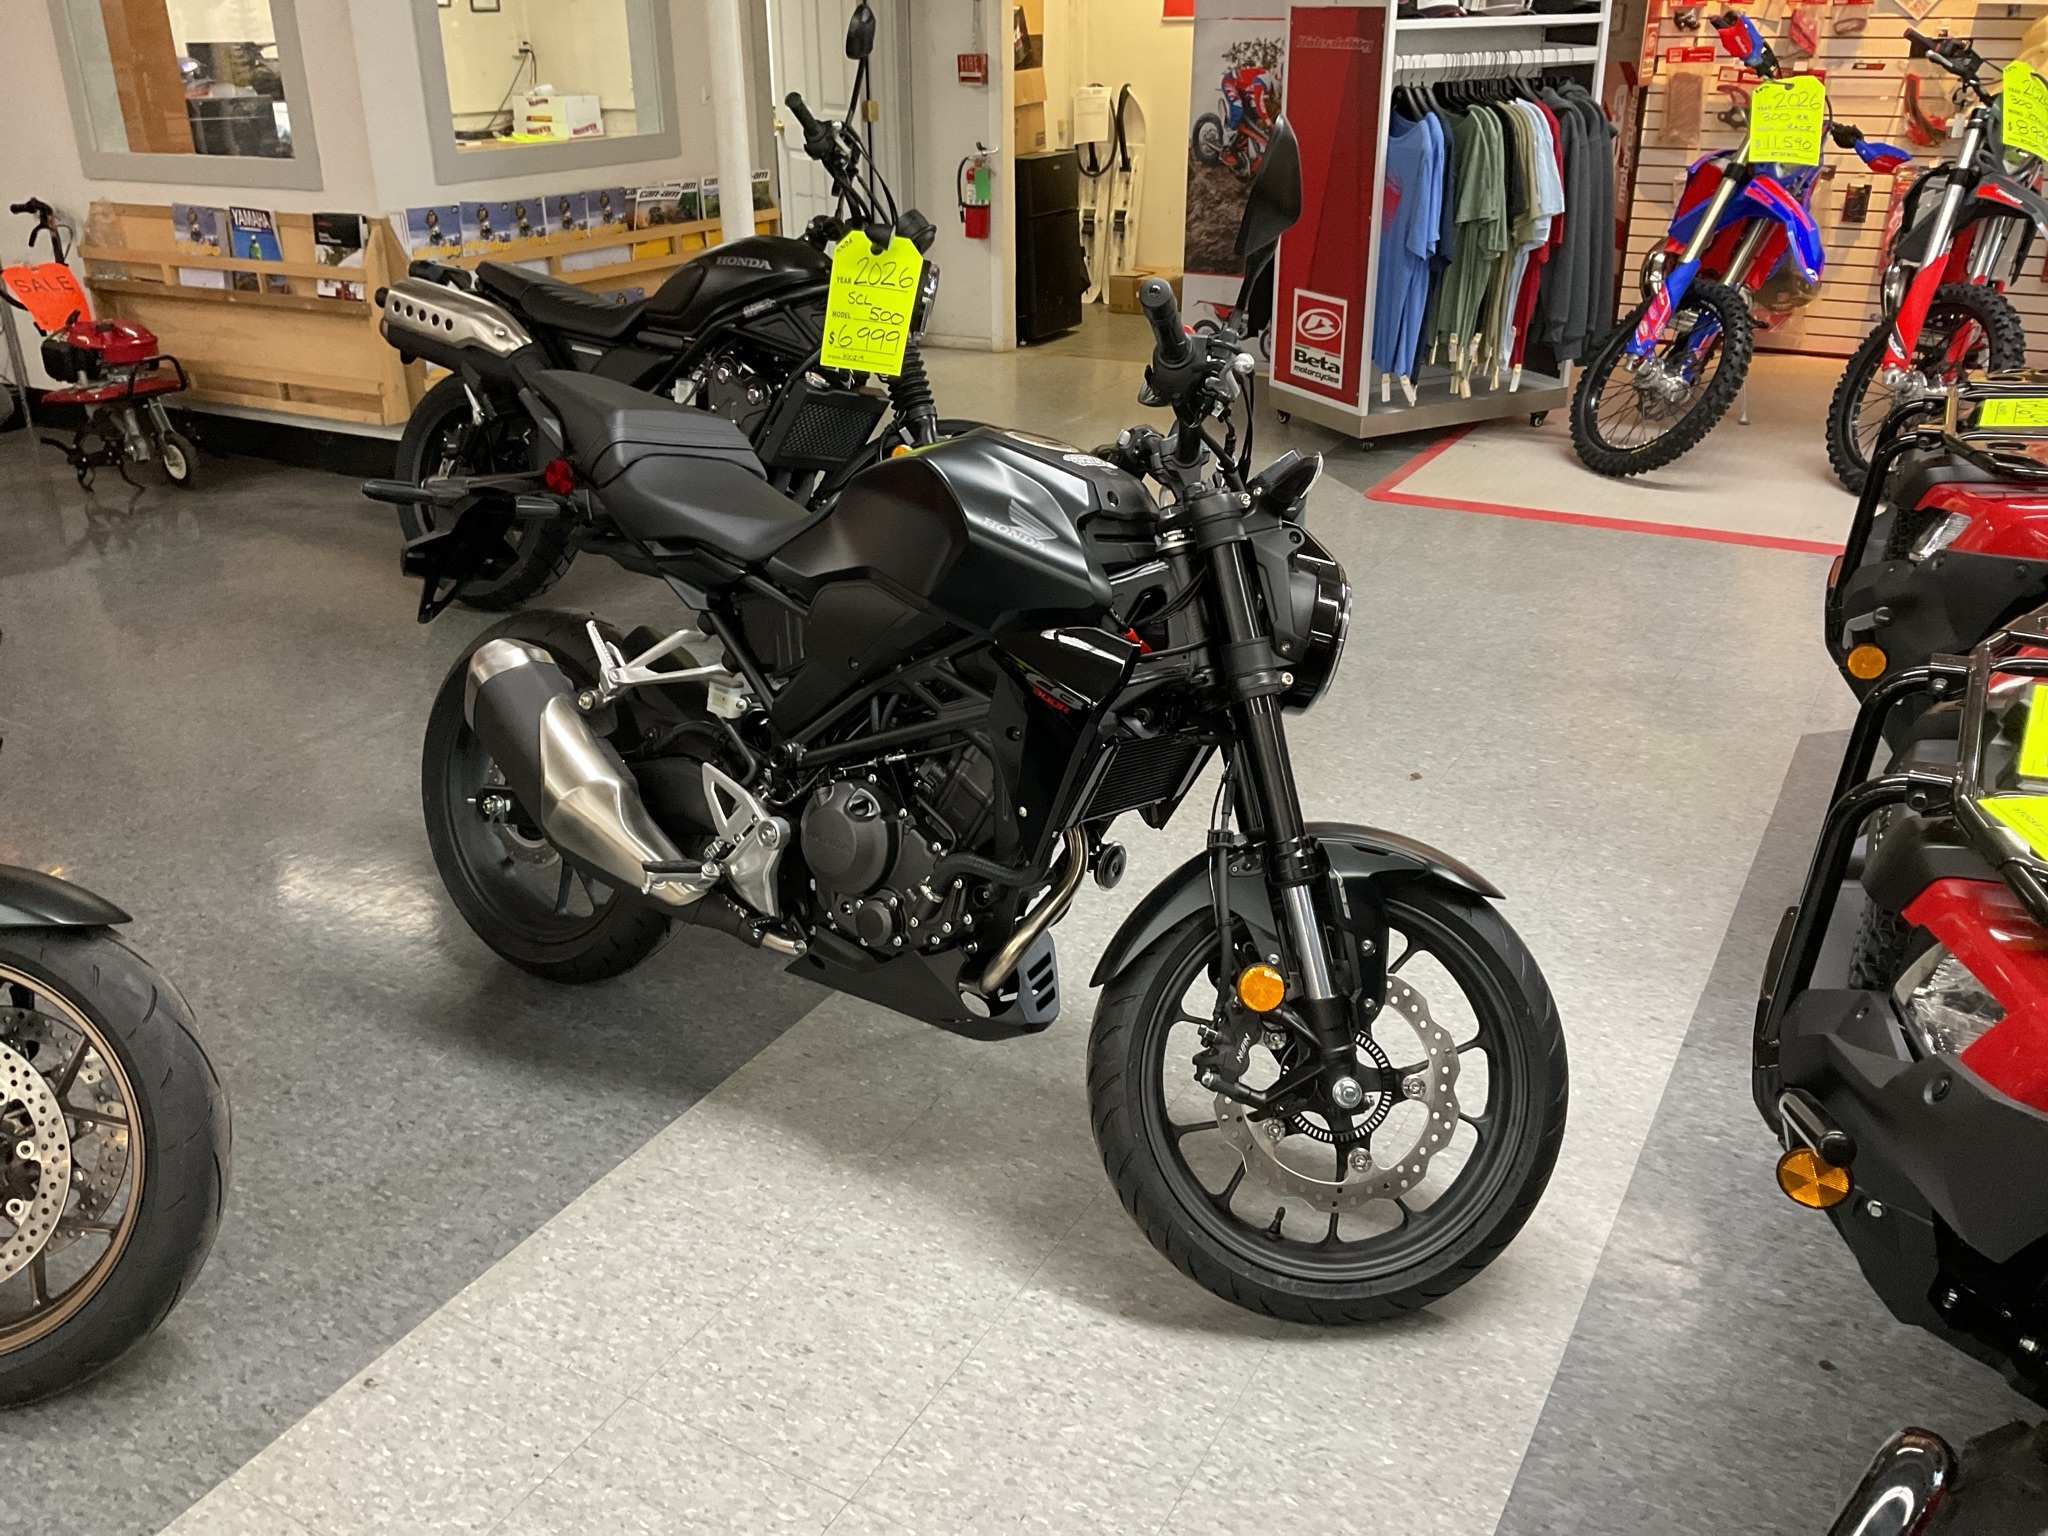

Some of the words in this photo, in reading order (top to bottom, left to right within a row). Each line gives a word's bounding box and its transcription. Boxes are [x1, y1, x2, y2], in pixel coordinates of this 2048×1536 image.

[1773, 92, 1822, 110] 2026
[2009, 95, 2033, 110] 300
[1762, 112, 1791, 121] 300
[638, 189, 681, 199] can-am
[231, 208, 271, 229] YAMAHA
[716, 256, 773, 271] HONDA
[837, 276, 852, 284] YEAR
[853, 256, 914, 289] 2026
[13, 275, 75, 293] SALE
[848, 291, 873, 306] SCL
[832, 310, 852, 319] MODEL
[869, 306, 905, 325] 500
[1294, 347, 1341, 375] Beta
[1293, 365, 1340, 384] motorcycles
[981, 517, 1048, 553] HONDA
